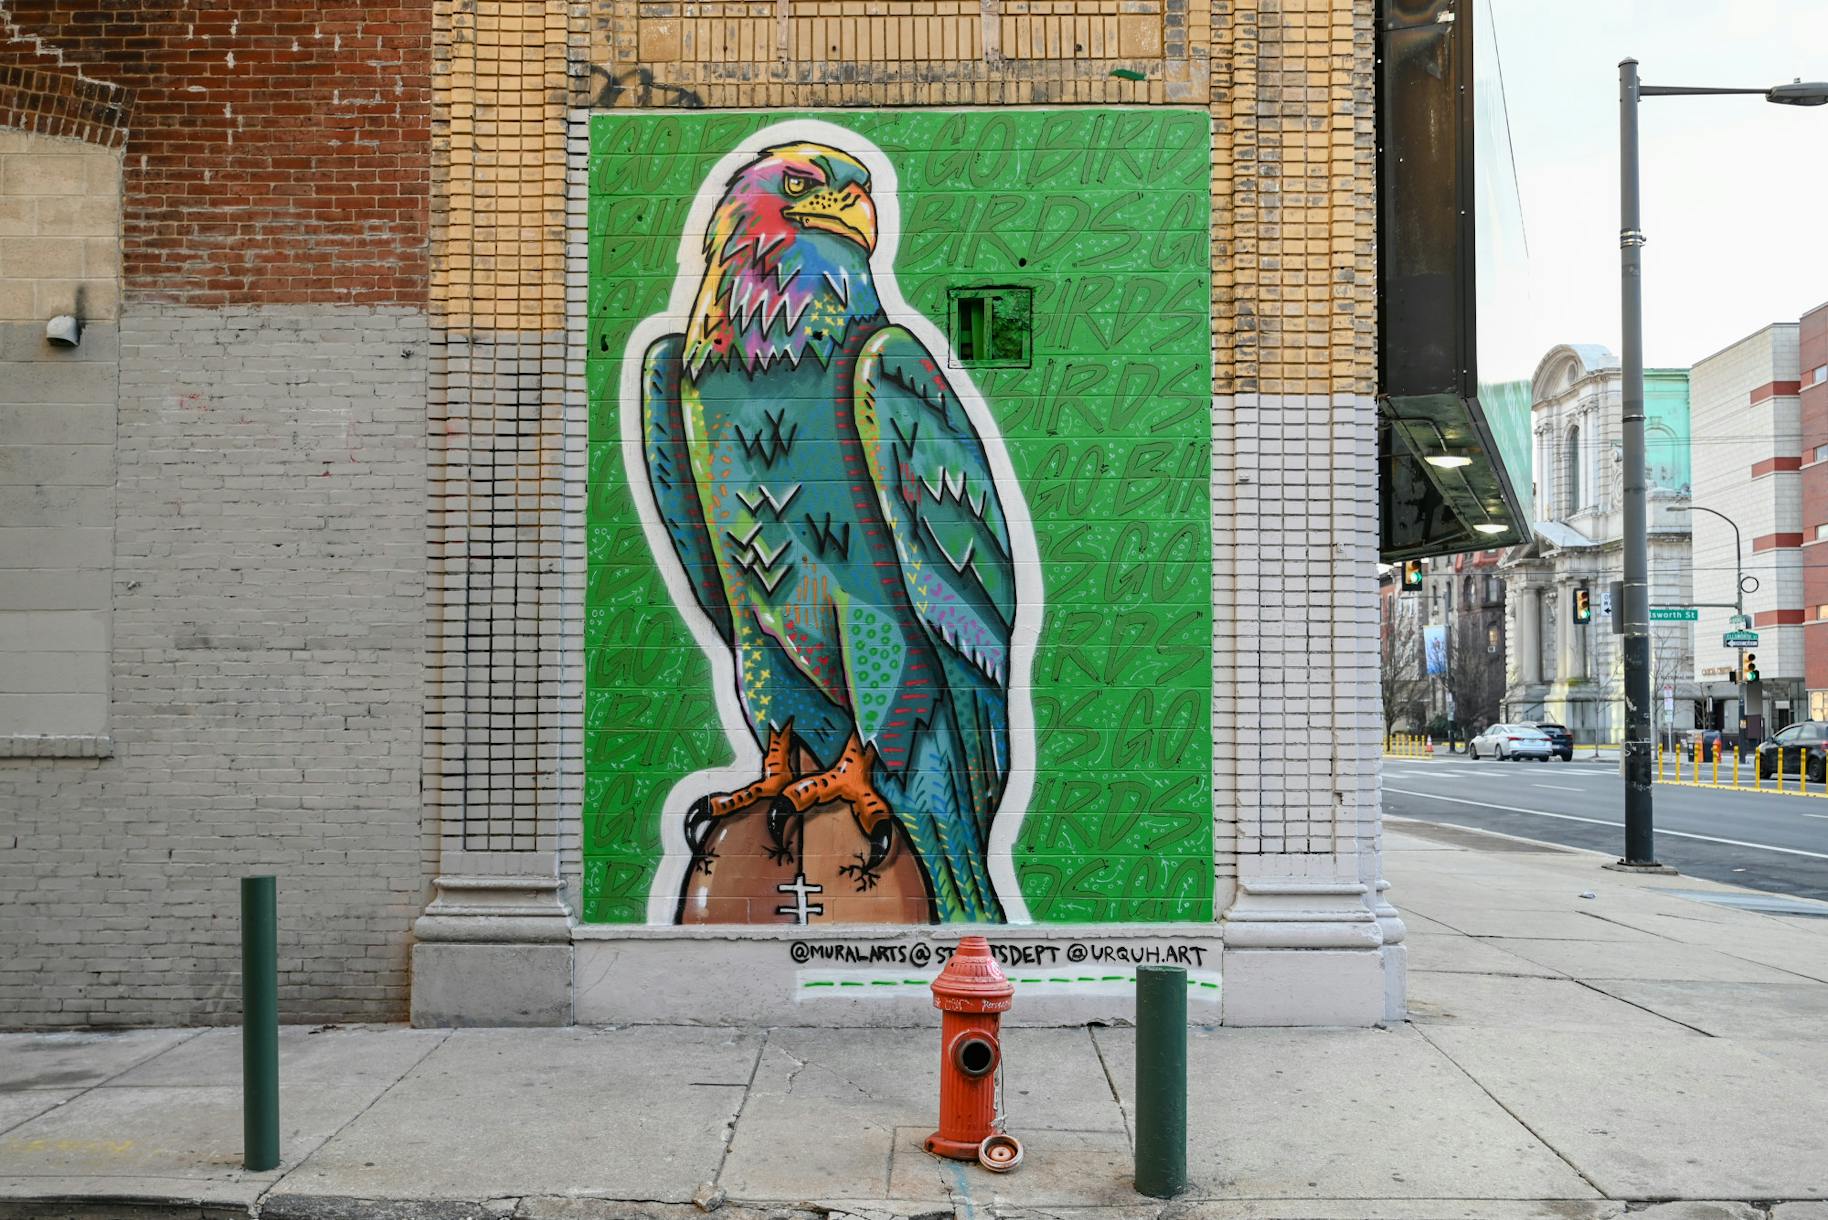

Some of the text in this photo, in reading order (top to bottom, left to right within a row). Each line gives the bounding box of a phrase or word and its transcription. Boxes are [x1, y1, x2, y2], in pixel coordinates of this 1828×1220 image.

[598, 116, 682, 193] GO
[924, 112, 1017, 188] GO
[1025, 110, 1209, 185] BIRD
[901, 191, 1143, 268] BIRDS
[981, 360, 1204, 434] BIRDS
[1027, 442, 1105, 520] GO
[1104, 521, 1200, 602] GO
[595, 607, 674, 686] GO
[1685, 611, 1695, 619] St
[1112, 688, 1201, 768] GO
[1019, 776, 1201, 850] IRDS
[790, 941, 907, 964] @MURALARTS
[1067, 943, 1208, 967] @URQUH.ART
